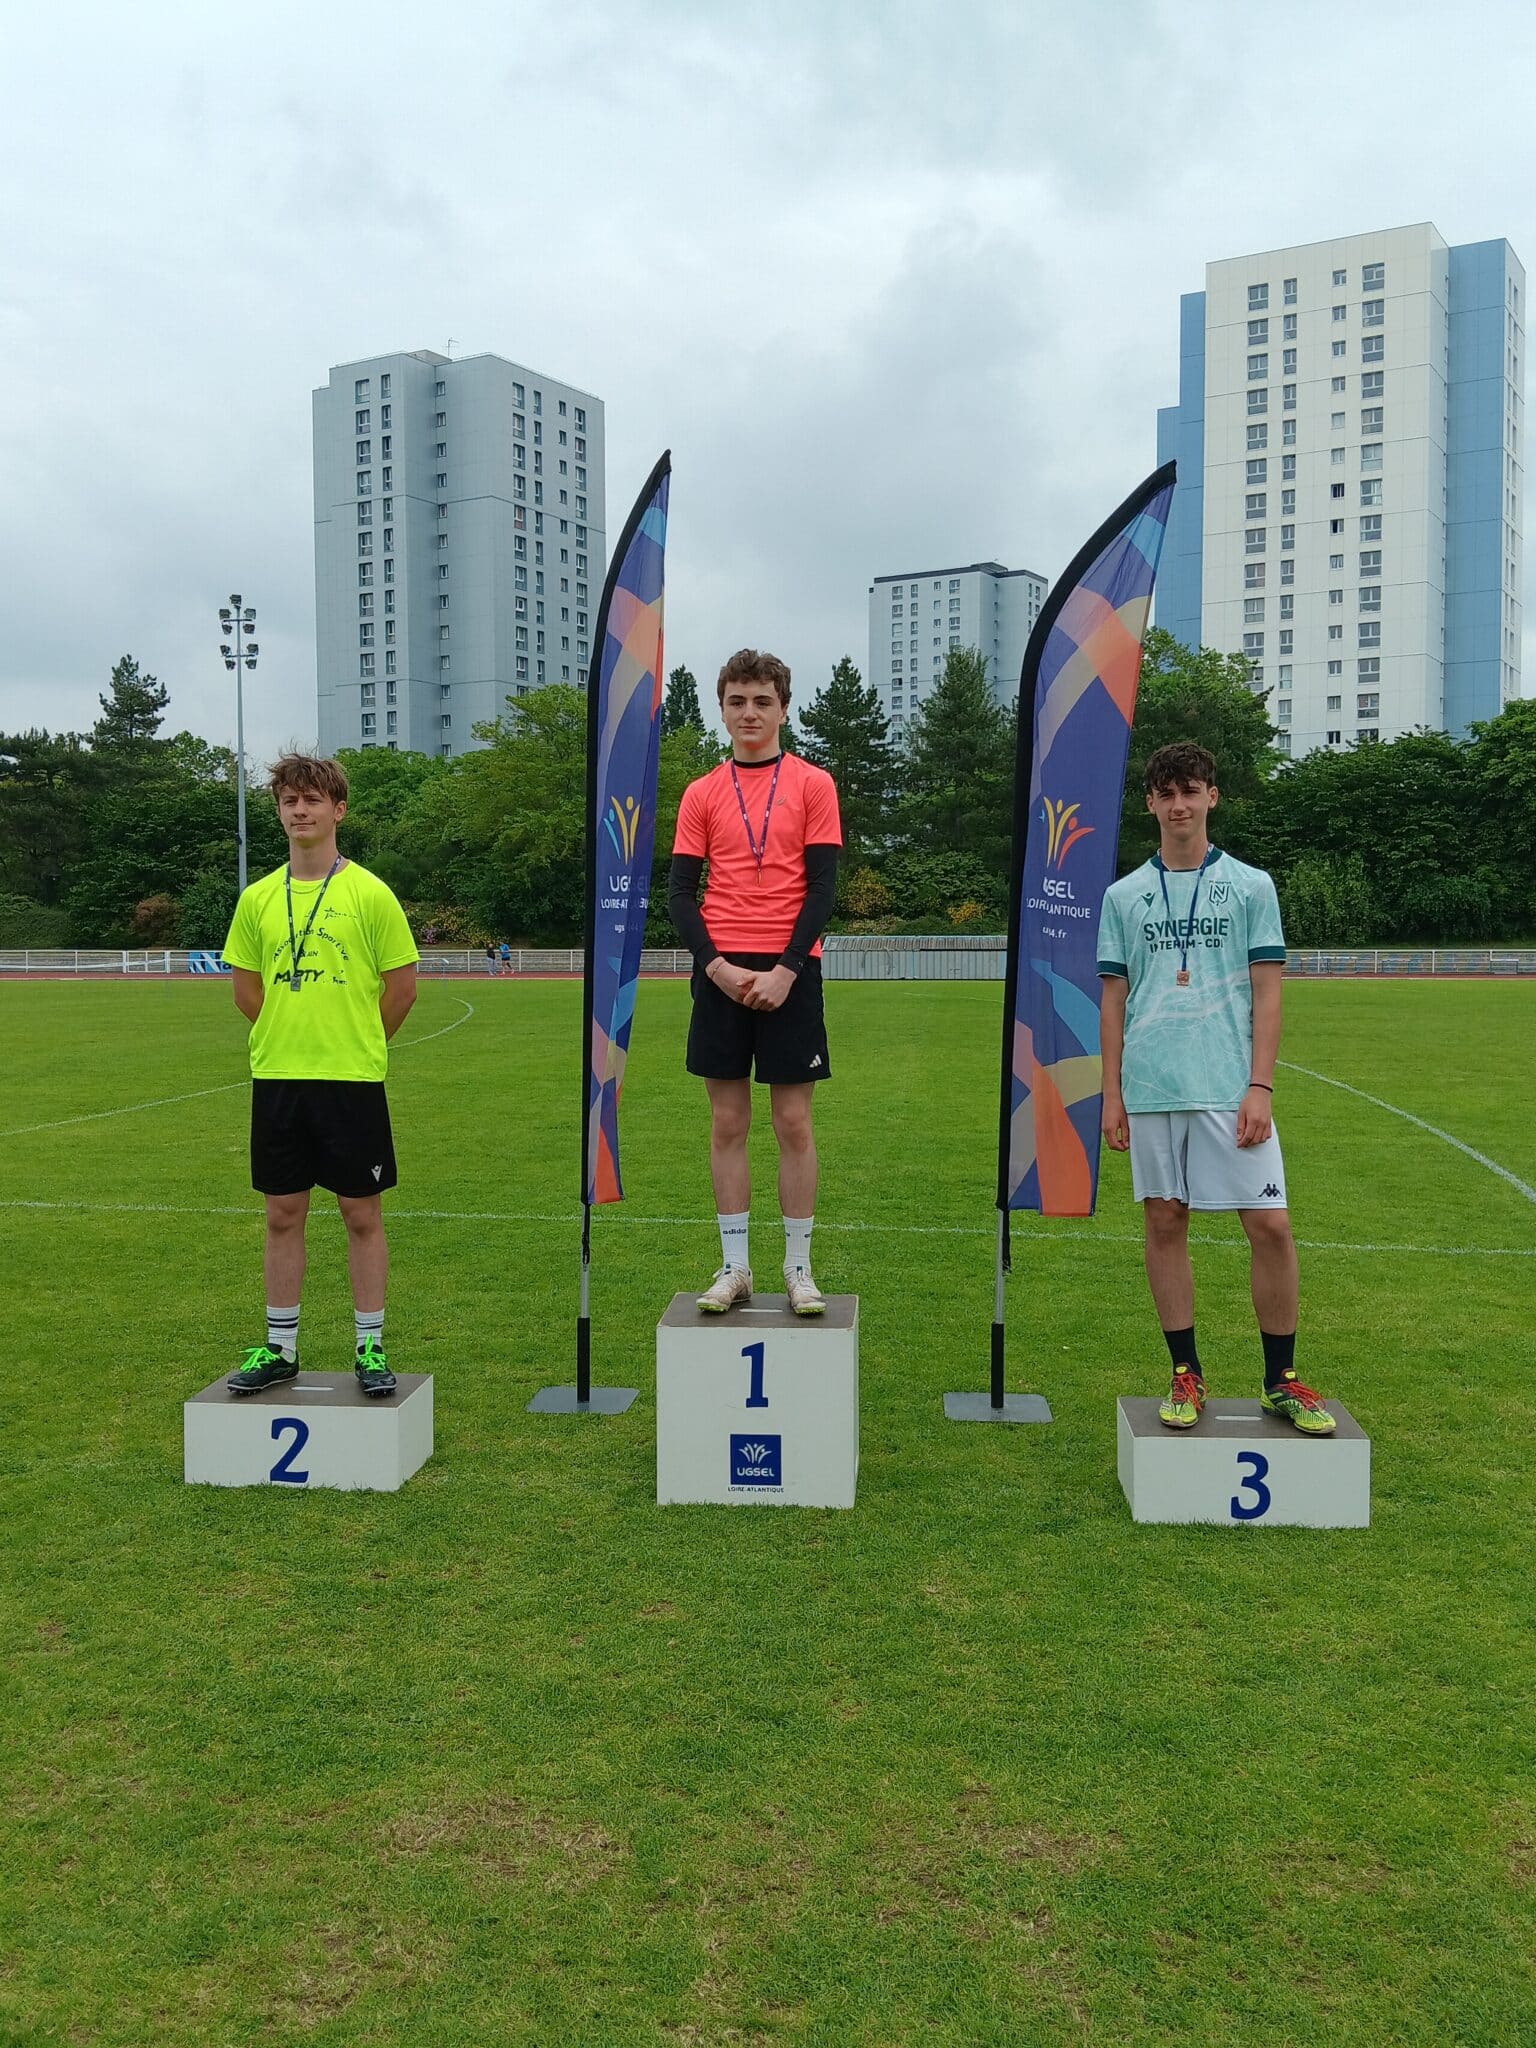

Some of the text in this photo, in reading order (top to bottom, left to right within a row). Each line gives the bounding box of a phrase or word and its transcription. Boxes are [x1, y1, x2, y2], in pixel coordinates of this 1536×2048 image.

[1143, 917, 1230, 942] SYNERGIE
[741, 1341, 769, 1409] 1
[269, 1417, 310, 1484] 2
[736, 1467, 775, 1477] UGSEL
[1230, 1451, 1272, 1520] 3
